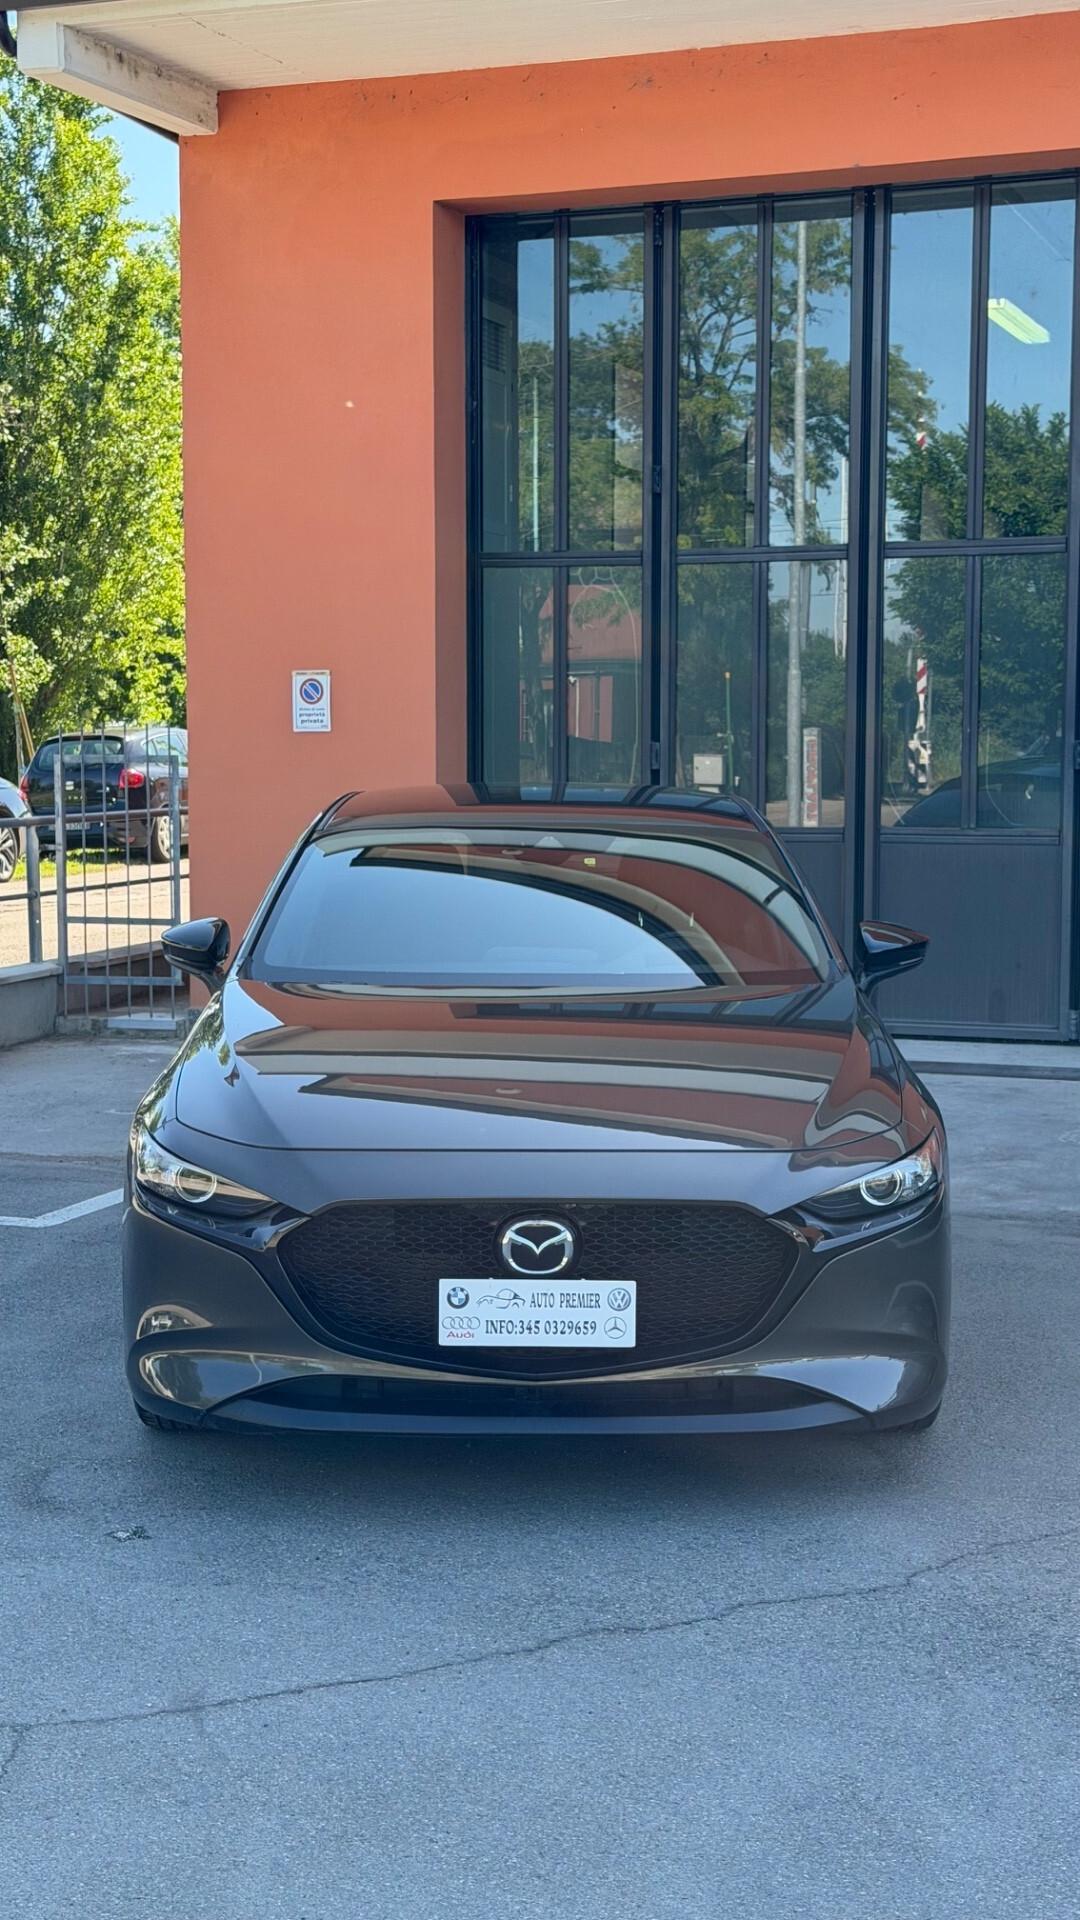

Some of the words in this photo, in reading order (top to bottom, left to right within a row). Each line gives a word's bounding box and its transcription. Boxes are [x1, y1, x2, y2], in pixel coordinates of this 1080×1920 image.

[529, 1292, 555, 1308] AUTO
[559, 1292, 601, 1309] PREMIER
[446, 1330, 475, 1339] Audi
[485, 1319, 540, 1335] INFO:345
[544, 1320, 597, 1335] 0329659
